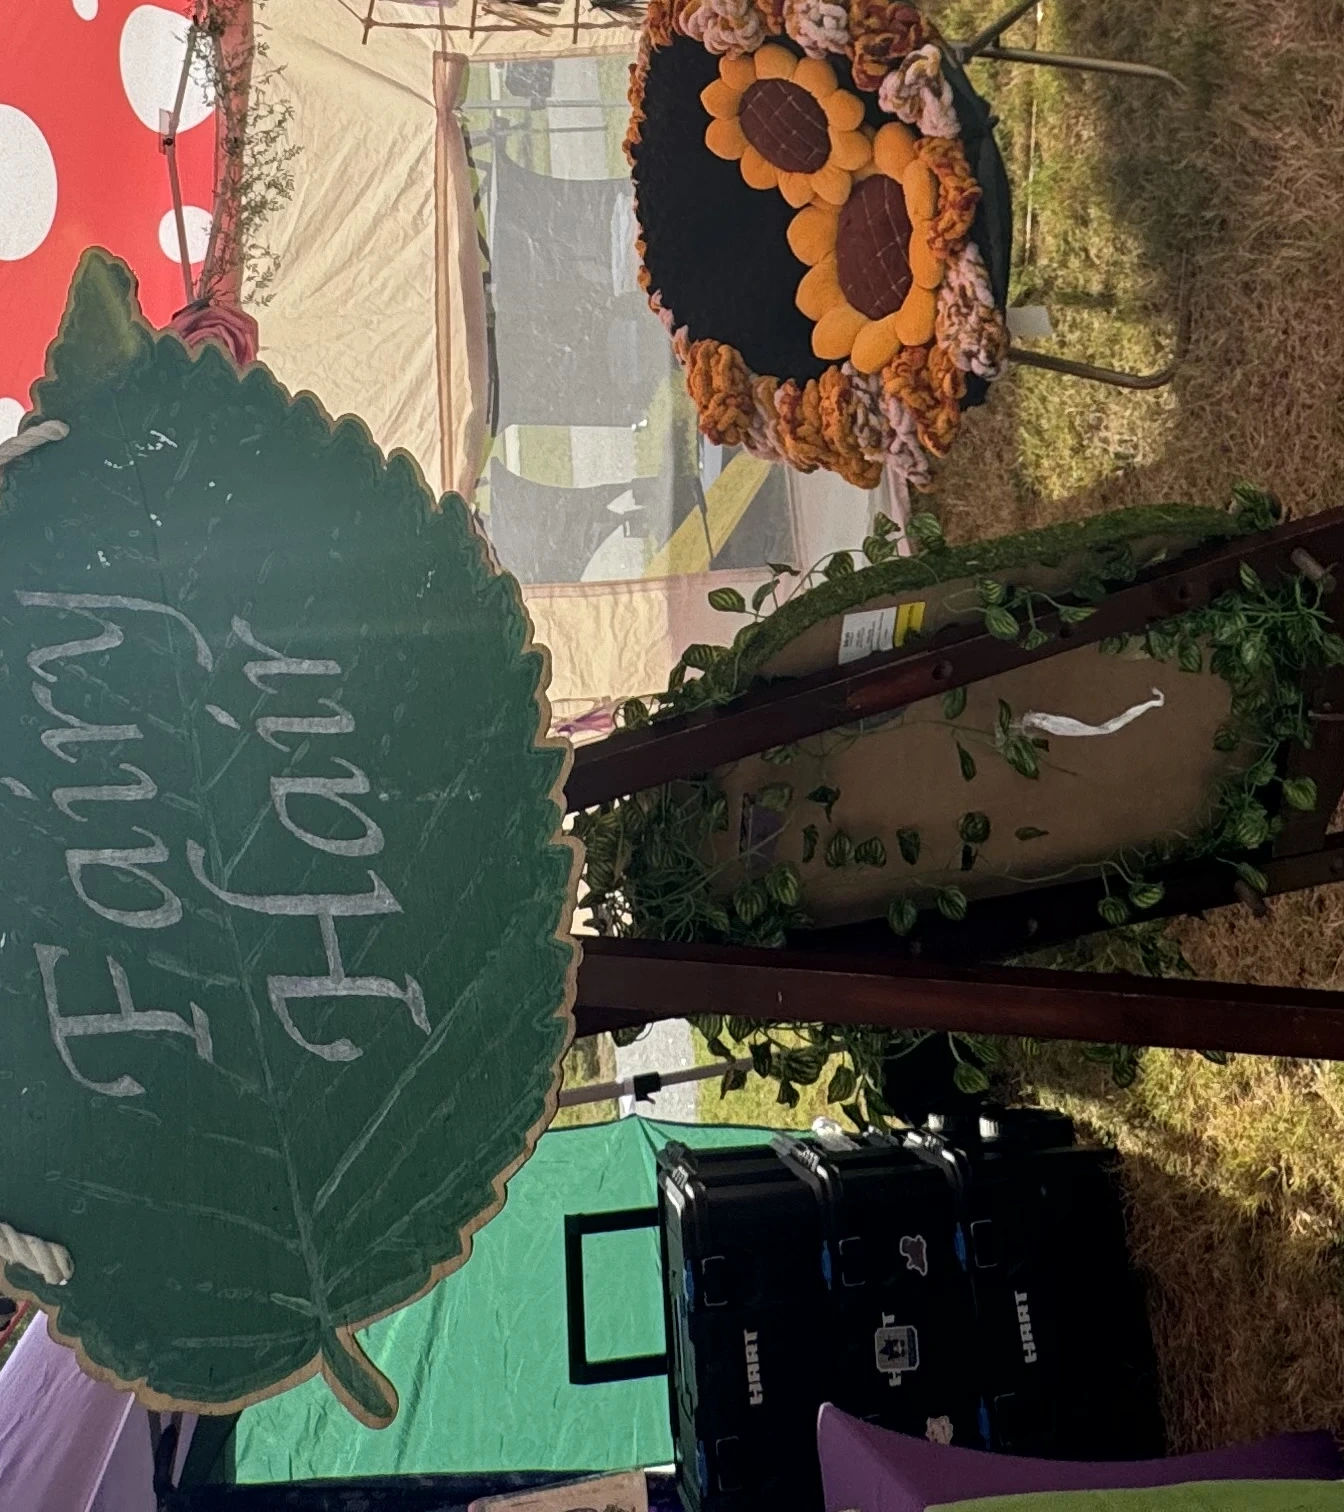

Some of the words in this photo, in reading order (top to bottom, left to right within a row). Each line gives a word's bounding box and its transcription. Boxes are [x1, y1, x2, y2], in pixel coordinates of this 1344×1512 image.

[185, 615, 432, 1062] Hair
[882, 1312, 902, 1387] HT
[1014, 1291, 1037, 1363] HART
[744, 1329, 763, 1405] HART
